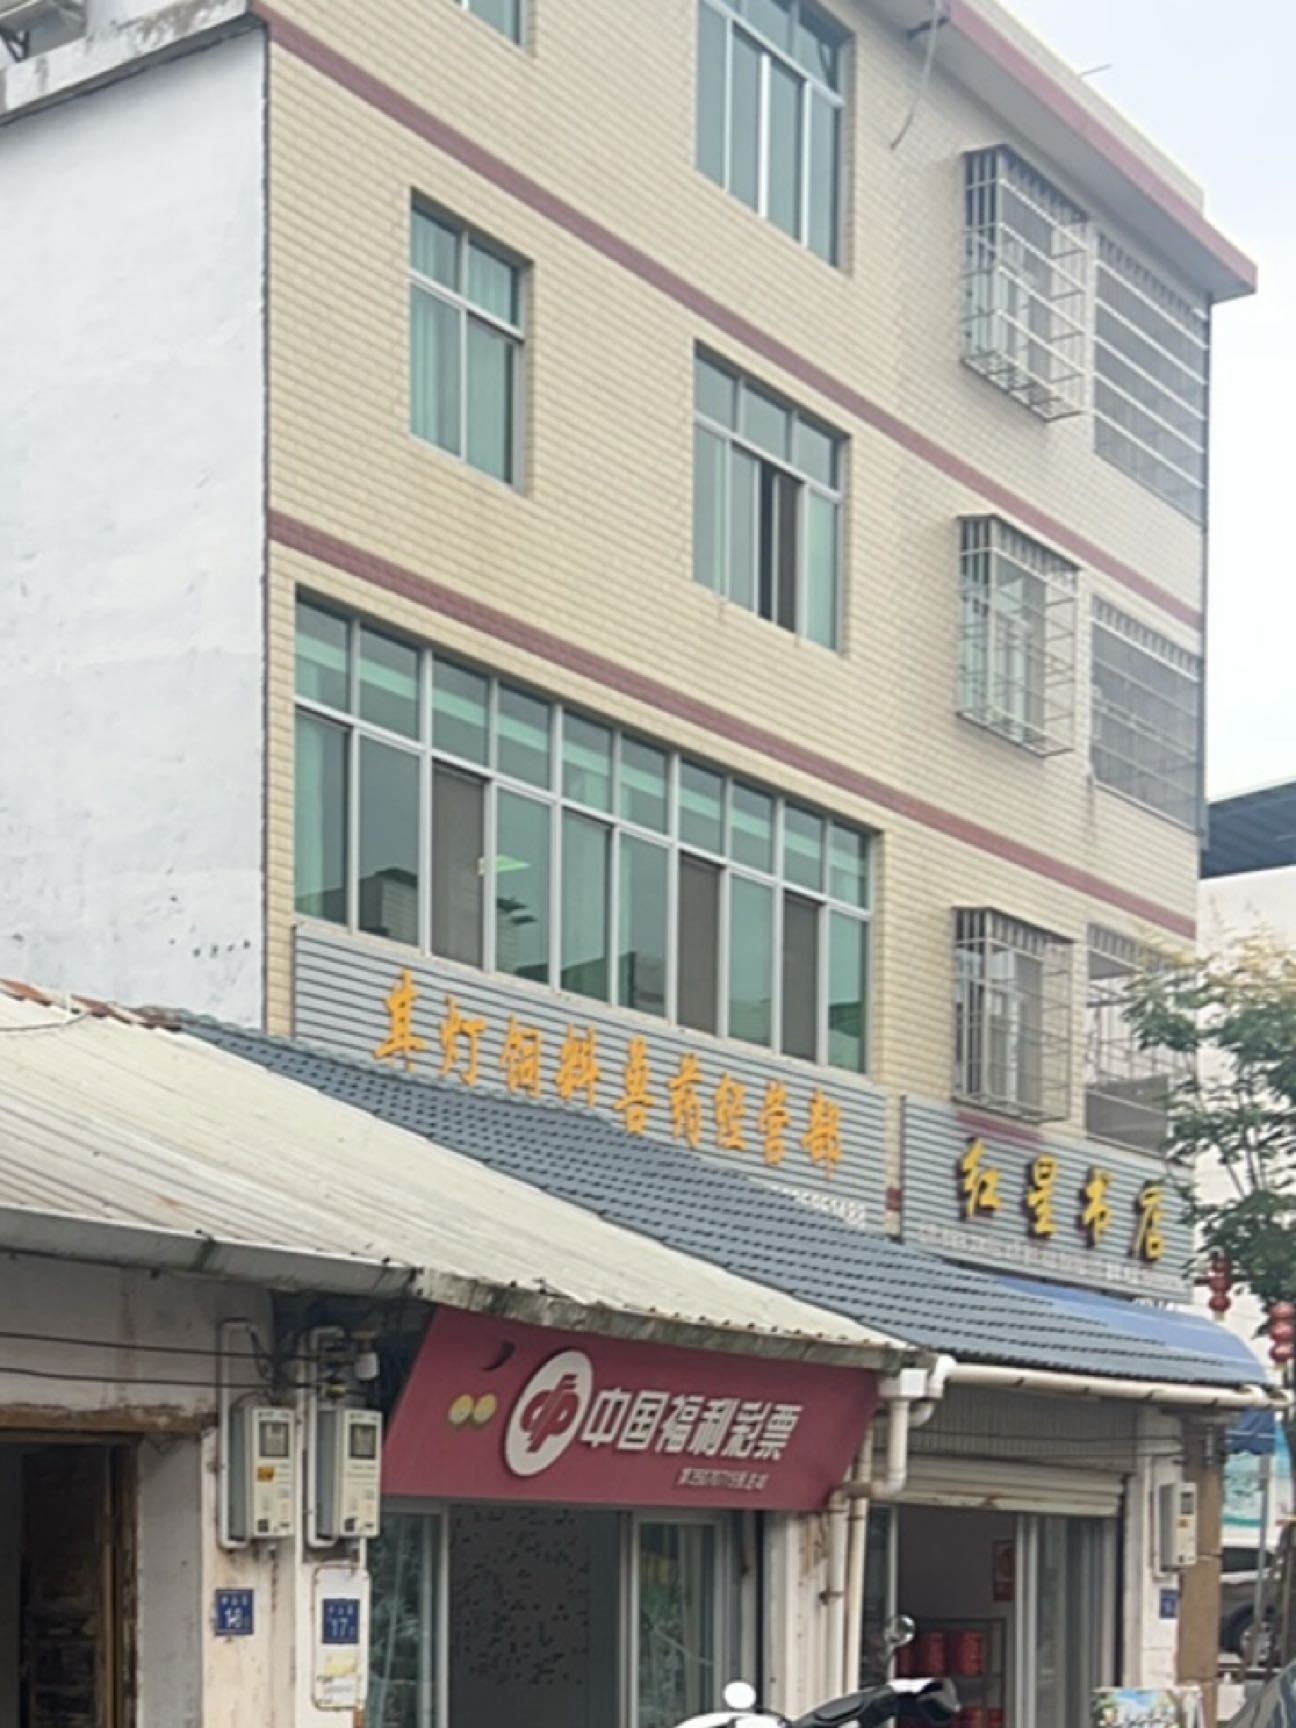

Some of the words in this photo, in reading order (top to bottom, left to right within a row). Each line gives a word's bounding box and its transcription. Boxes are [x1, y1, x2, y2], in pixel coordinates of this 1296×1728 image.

[581, 1386, 802, 1460] 中国福利彩票
